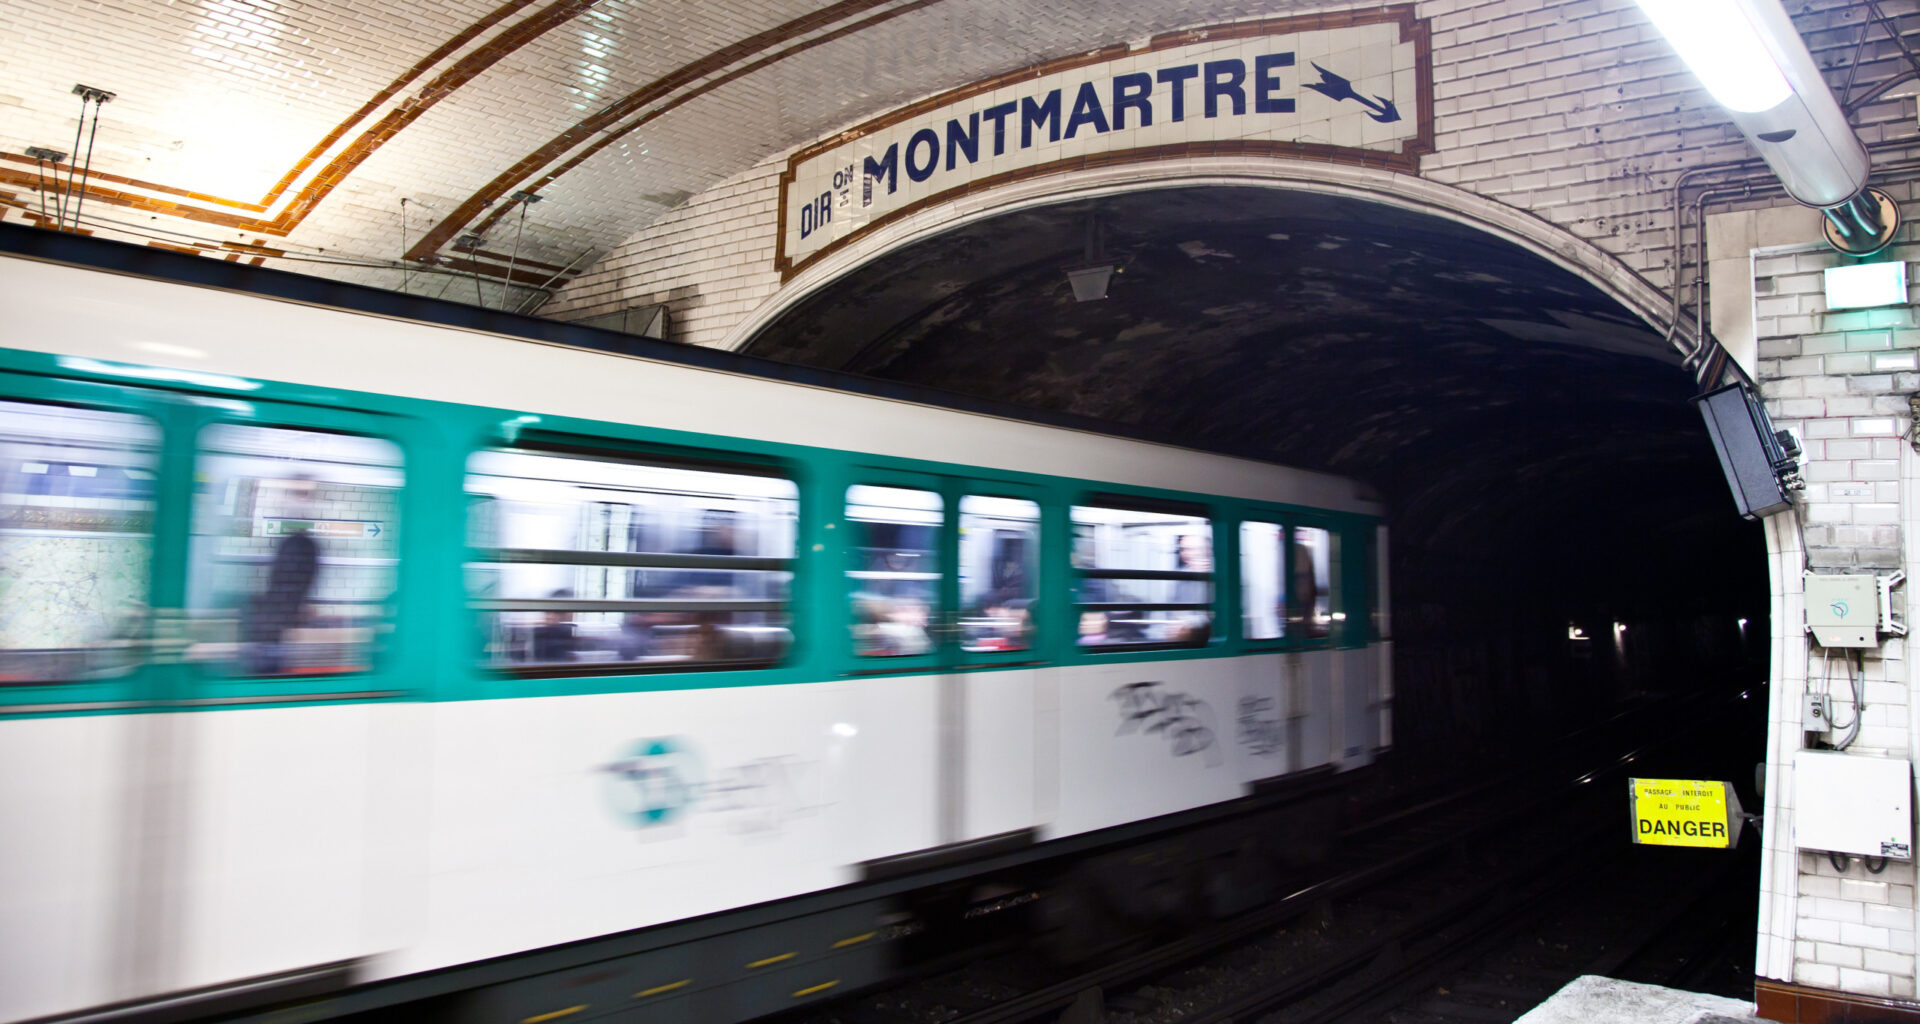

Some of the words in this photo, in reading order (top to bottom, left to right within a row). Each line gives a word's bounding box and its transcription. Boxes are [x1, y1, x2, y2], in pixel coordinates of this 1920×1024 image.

[801, 190, 831, 240] DIR
[863, 51, 1296, 208] MONTMARTRE
[1640, 819, 1725, 837] DANGER
